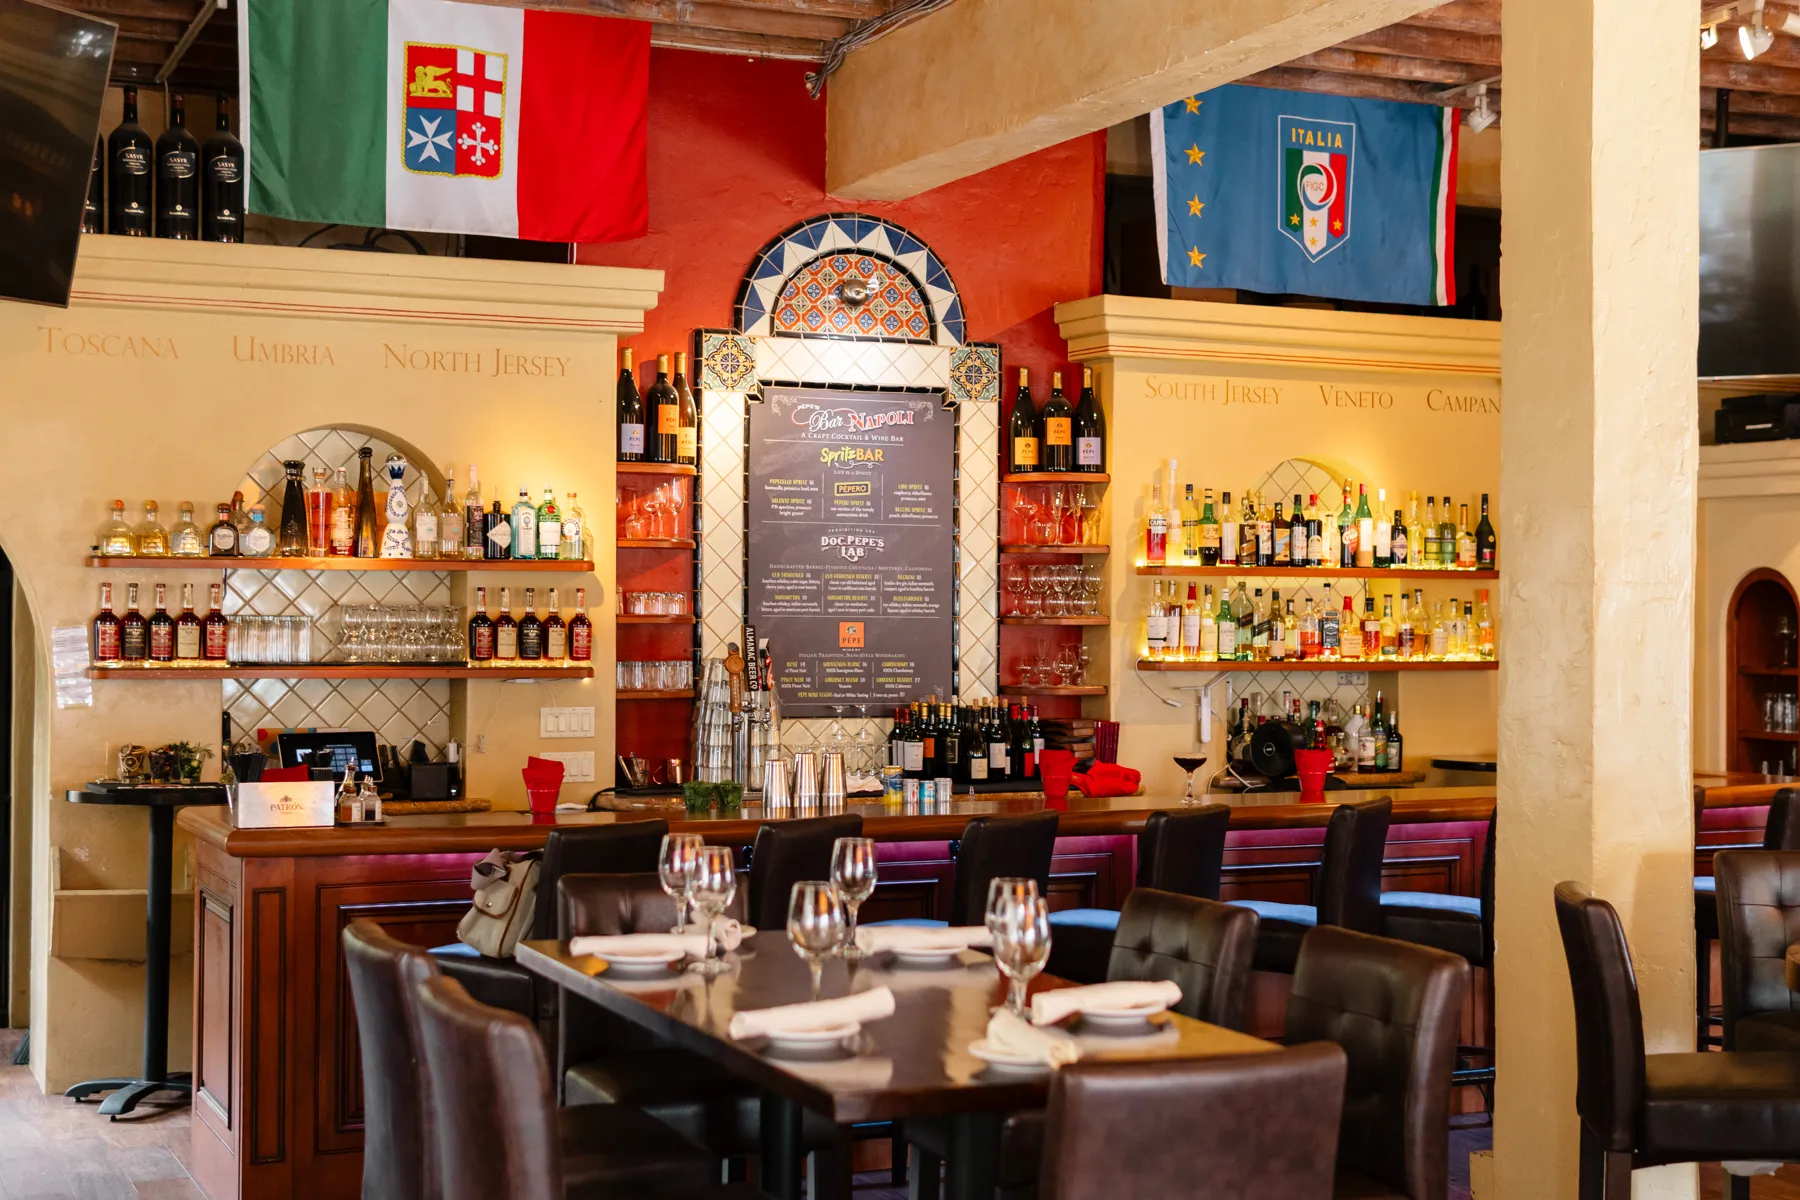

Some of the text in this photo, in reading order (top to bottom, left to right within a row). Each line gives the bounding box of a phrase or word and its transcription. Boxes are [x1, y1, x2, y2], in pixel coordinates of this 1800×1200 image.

[1292, 128, 1342, 148] ITALIA
[1306, 181, 1324, 191] FIGC
[38, 327, 571, 377] TOSCANA UMBRIA NORTH JERSEY
[1145, 376, 1215, 401] SOUTH
[1222, 380, 1283, 405] JERSEY
[1319, 385, 1394, 409] VENETO
[808, 408, 914, 432] Bar NAPOLI
[839, 485, 866, 493] PÉPERO
[841, 546, 865, 562] LAB
[745, 627, 758, 690] ALMANAC BEER CO
